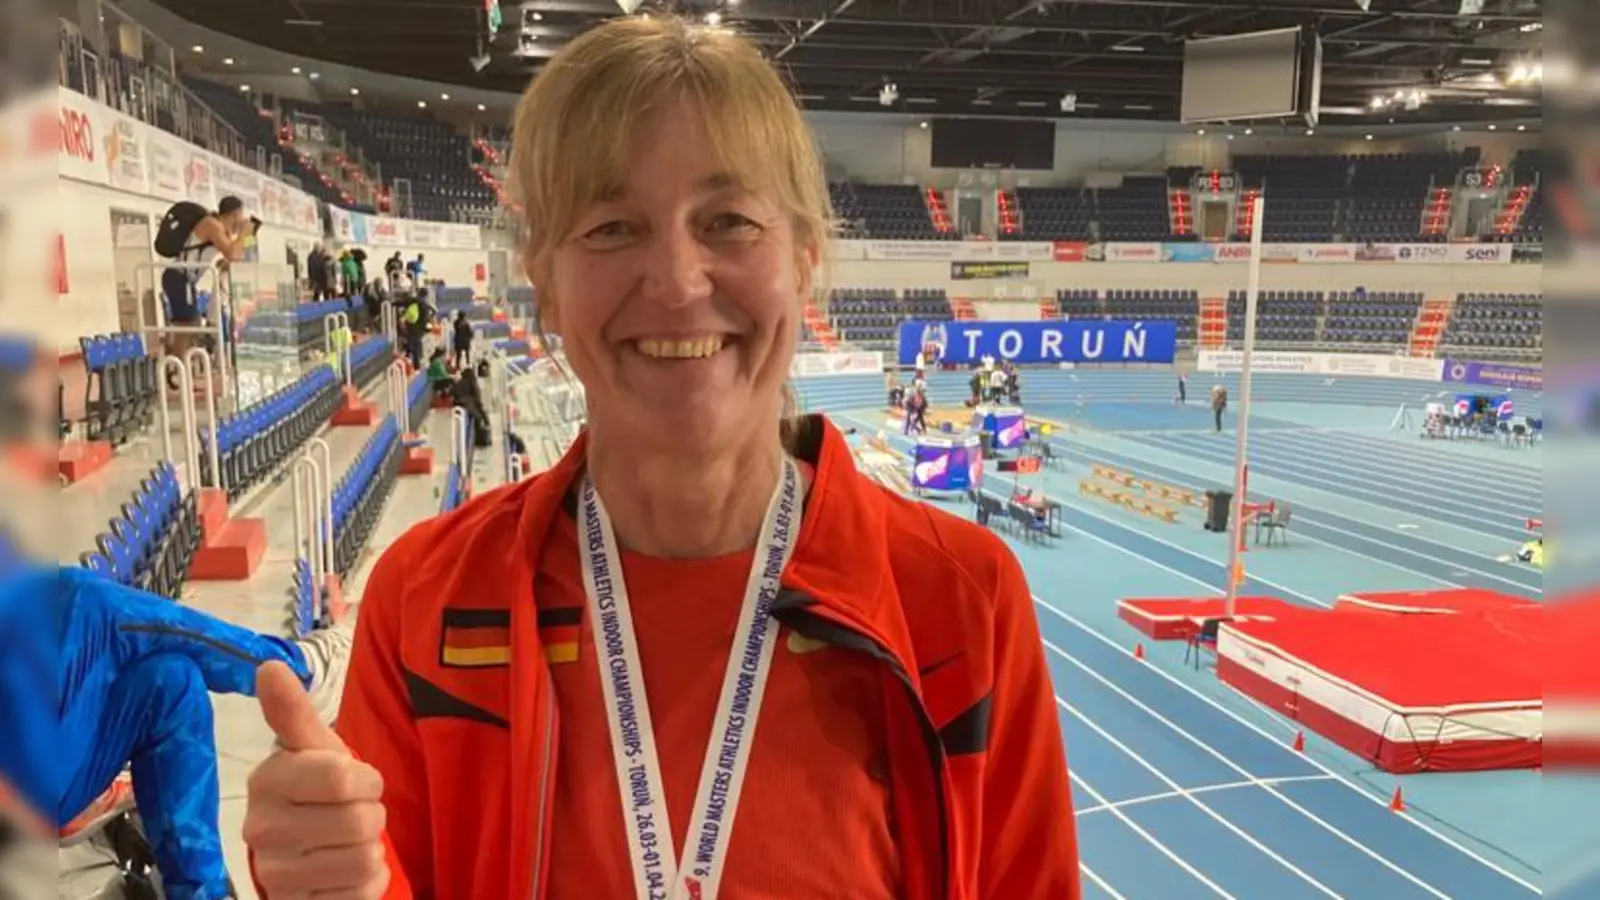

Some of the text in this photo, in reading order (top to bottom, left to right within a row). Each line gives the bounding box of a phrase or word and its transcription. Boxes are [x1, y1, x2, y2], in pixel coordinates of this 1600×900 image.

[963, 322, 1147, 358] TORUŃ
[585, 500, 605, 551] MASTERS
[591, 551, 616, 610] ATHLETICS
[601, 610, 624, 657] INDOOR
[742, 587, 777, 671] CHAMPIONSHIPS
[610, 658, 642, 757] CHAMPIONSHIPS
[731, 672, 755, 714] INDOOR
[718, 715, 745, 771] ATHLETICS
[705, 770, 732, 822] MASTERS
[696, 822, 719, 862] WORLD
[693, 866, 711, 877] 9.
